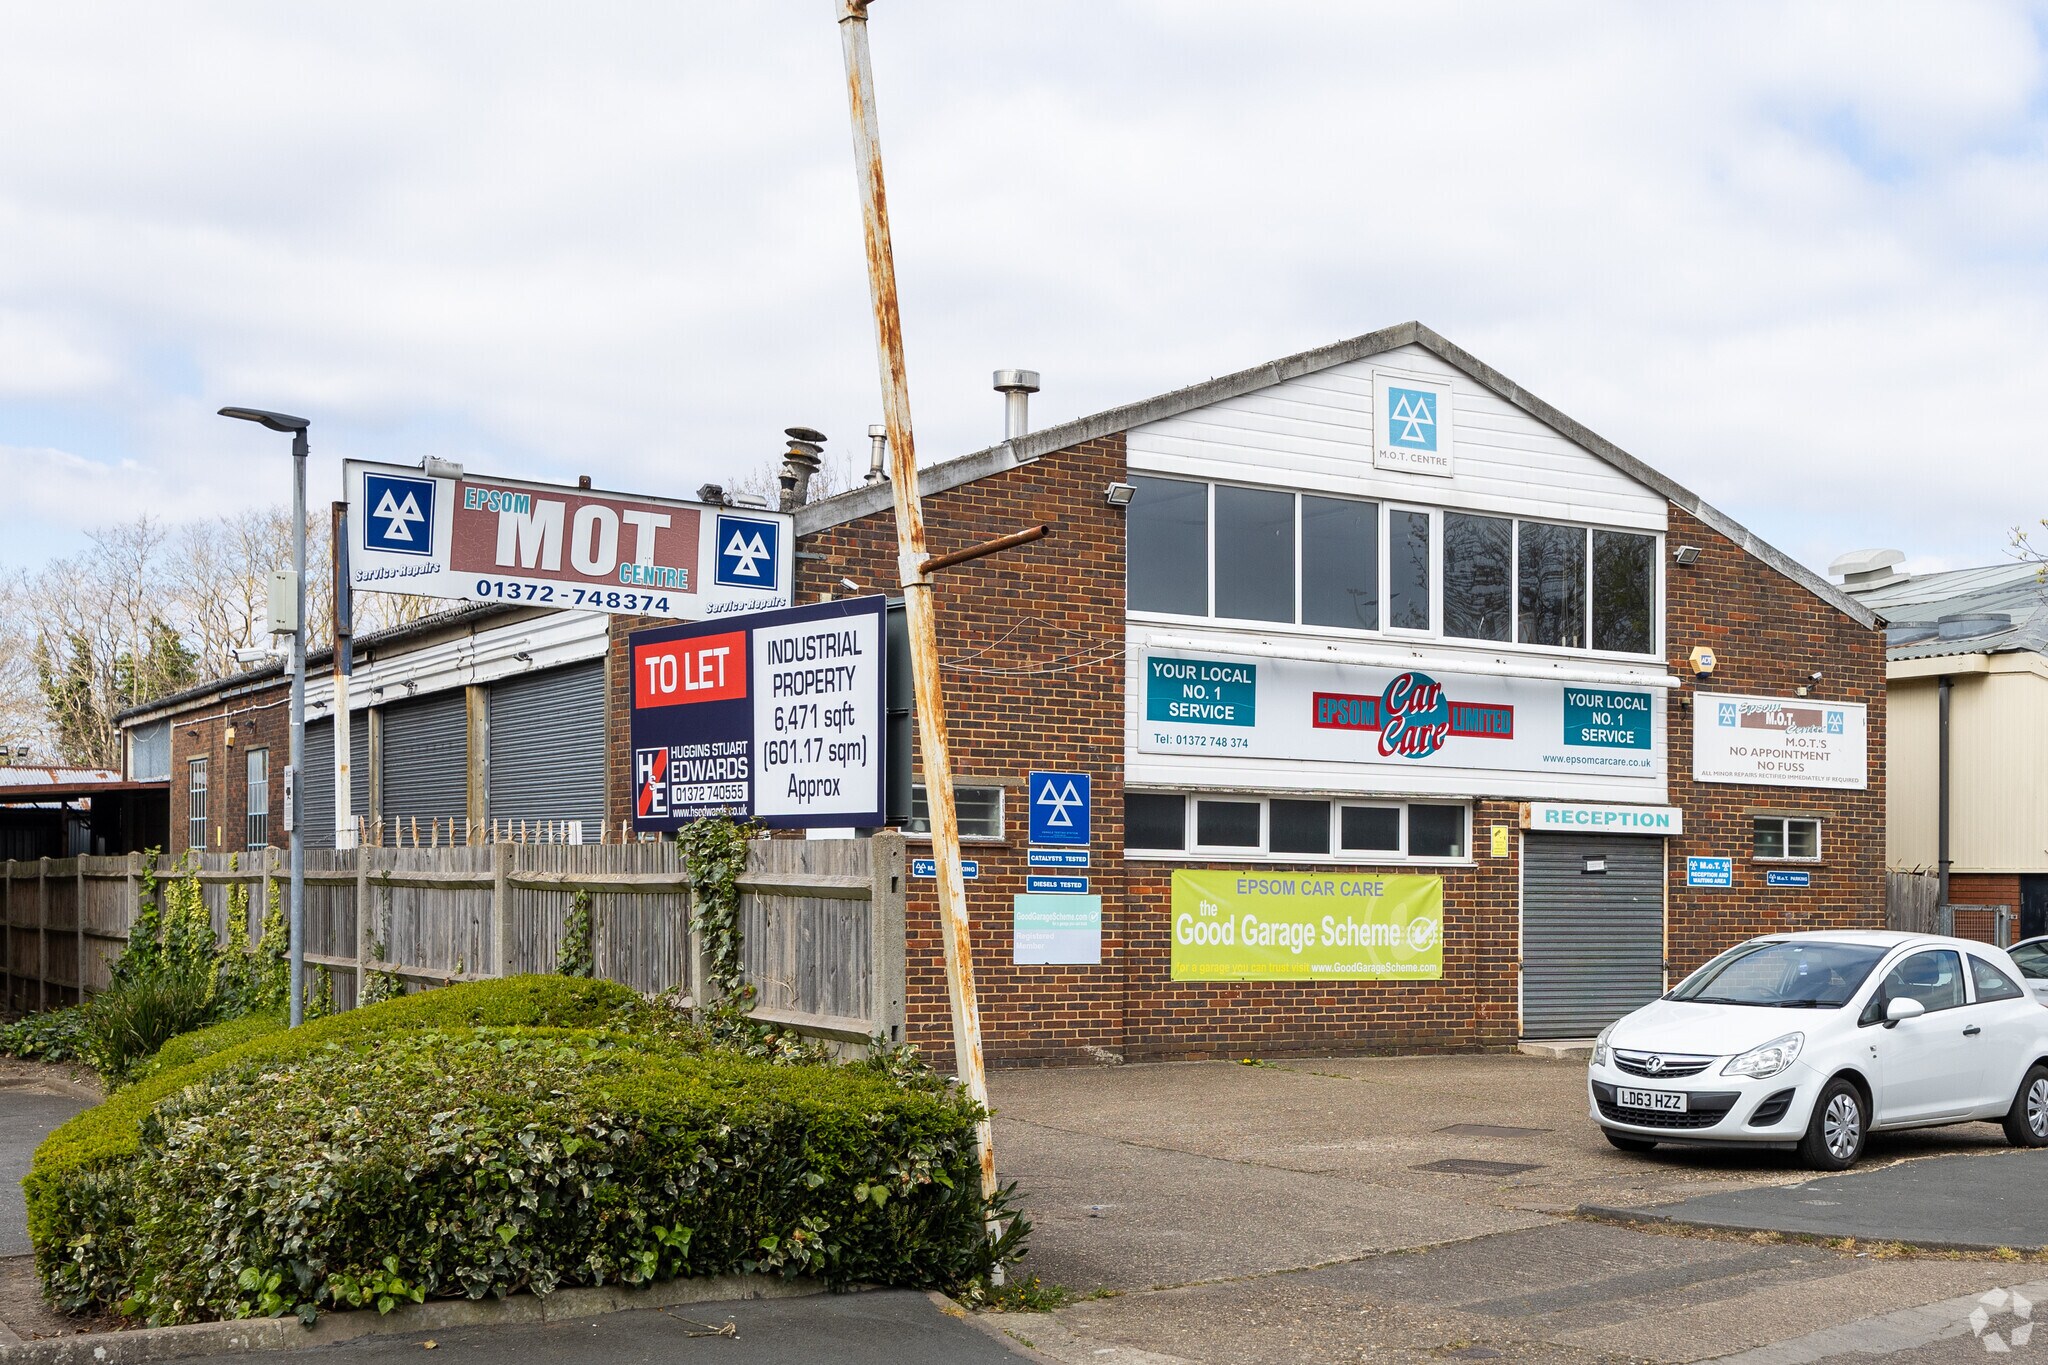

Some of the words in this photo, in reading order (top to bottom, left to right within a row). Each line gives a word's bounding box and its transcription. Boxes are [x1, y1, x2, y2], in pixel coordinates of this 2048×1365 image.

[1380, 450, 1408, 461] M.O.T.
[1410, 454, 1447, 466] CENTRE
[464, 487, 531, 514] EPSOM
[496, 499, 671, 576] MOT
[620, 562, 688, 588] CENTRE
[768, 630, 862, 665] INDUSTRIAL
[1701, 656, 1712, 664] ADT
[645, 654, 678, 694] TO
[684, 647, 729, 691] LET
[1153, 663, 1196, 680] YOUR
[1201, 666, 1252, 683] LOCAL
[774, 665, 856, 698] PROPERTY
[1183, 684, 1209, 700] NO.
[1214, 686, 1220, 700] 1
[1386, 672, 1442, 716] Car
[1568, 693, 1603, 708] YOUR
[1607, 696, 1648, 710] LOCAL
[1739, 702, 1782, 716] Epsom
[774, 704, 818, 734] 6,471
[824, 701, 855, 734] sqft
[1169, 702, 1234, 720] SERVICE
[1318, 698, 1374, 725] EPSOM
[1592, 712, 1614, 726] NO.
[1618, 714, 1622, 726] 1
[1766, 712, 1796, 726] M.O.T.
[1452, 707, 1511, 734] LIMITED
[1154, 734, 1172, 744] Tel:
[1176, 735, 1206, 746] 01372
[1210, 736, 1228, 747] 748
[1230, 738, 1248, 748] 374
[1378, 714, 1449, 757] Care
[1582, 728, 1634, 744] SERVICE
[671, 744, 710, 759] HUGGINS
[712, 741, 748, 756] STUART
[764, 738, 823, 772] (601.17
[828, 734, 866, 768] sqm)
[1730, 746, 1748, 756] NO
[1750, 748, 1831, 761] APPOINTMENT
[672, 757, 748, 782] EDWARDS
[1542, 755, 1651, 767] www.epsomcarcare.co.uk
[1758, 762, 1774, 771] NO
[1778, 762, 1805, 772] FUSS
[1788, 774, 1824, 782] IMMEDIATELY
[676, 786, 704, 802] 01372
[708, 784, 743, 800] 740555
[788, 773, 840, 804] Approx
[1545, 810, 1670, 827] RECEPTION
[1236, 879, 1295, 896] EPSOM
[1301, 881, 1334, 896] CAR
[1340, 882, 1384, 896] CARE
[1016, 912, 1088, 922] GoodGarageScheme.com
[1200, 900, 1218, 916] the
[1016, 932, 1055, 940] Registered
[1176, 912, 1234, 946] Good
[1241, 914, 1316, 954] Garage
[1321, 915, 1400, 946] Scheme
[1177, 962, 1190, 972] for
[1192, 964, 1198, 972] a
[1200, 964, 1230, 975] garage
[1232, 964, 1248, 974] you
[1251, 964, 1266, 972] can
[1269, 963, 1288, 972] trust
[1292, 962, 1310, 972] visit
[1311, 962, 1437, 974] www.GoodGarageScheme.com
[1622, 1090, 1652, 1106] LD63
[1655, 1094, 1681, 1109] HZZ
